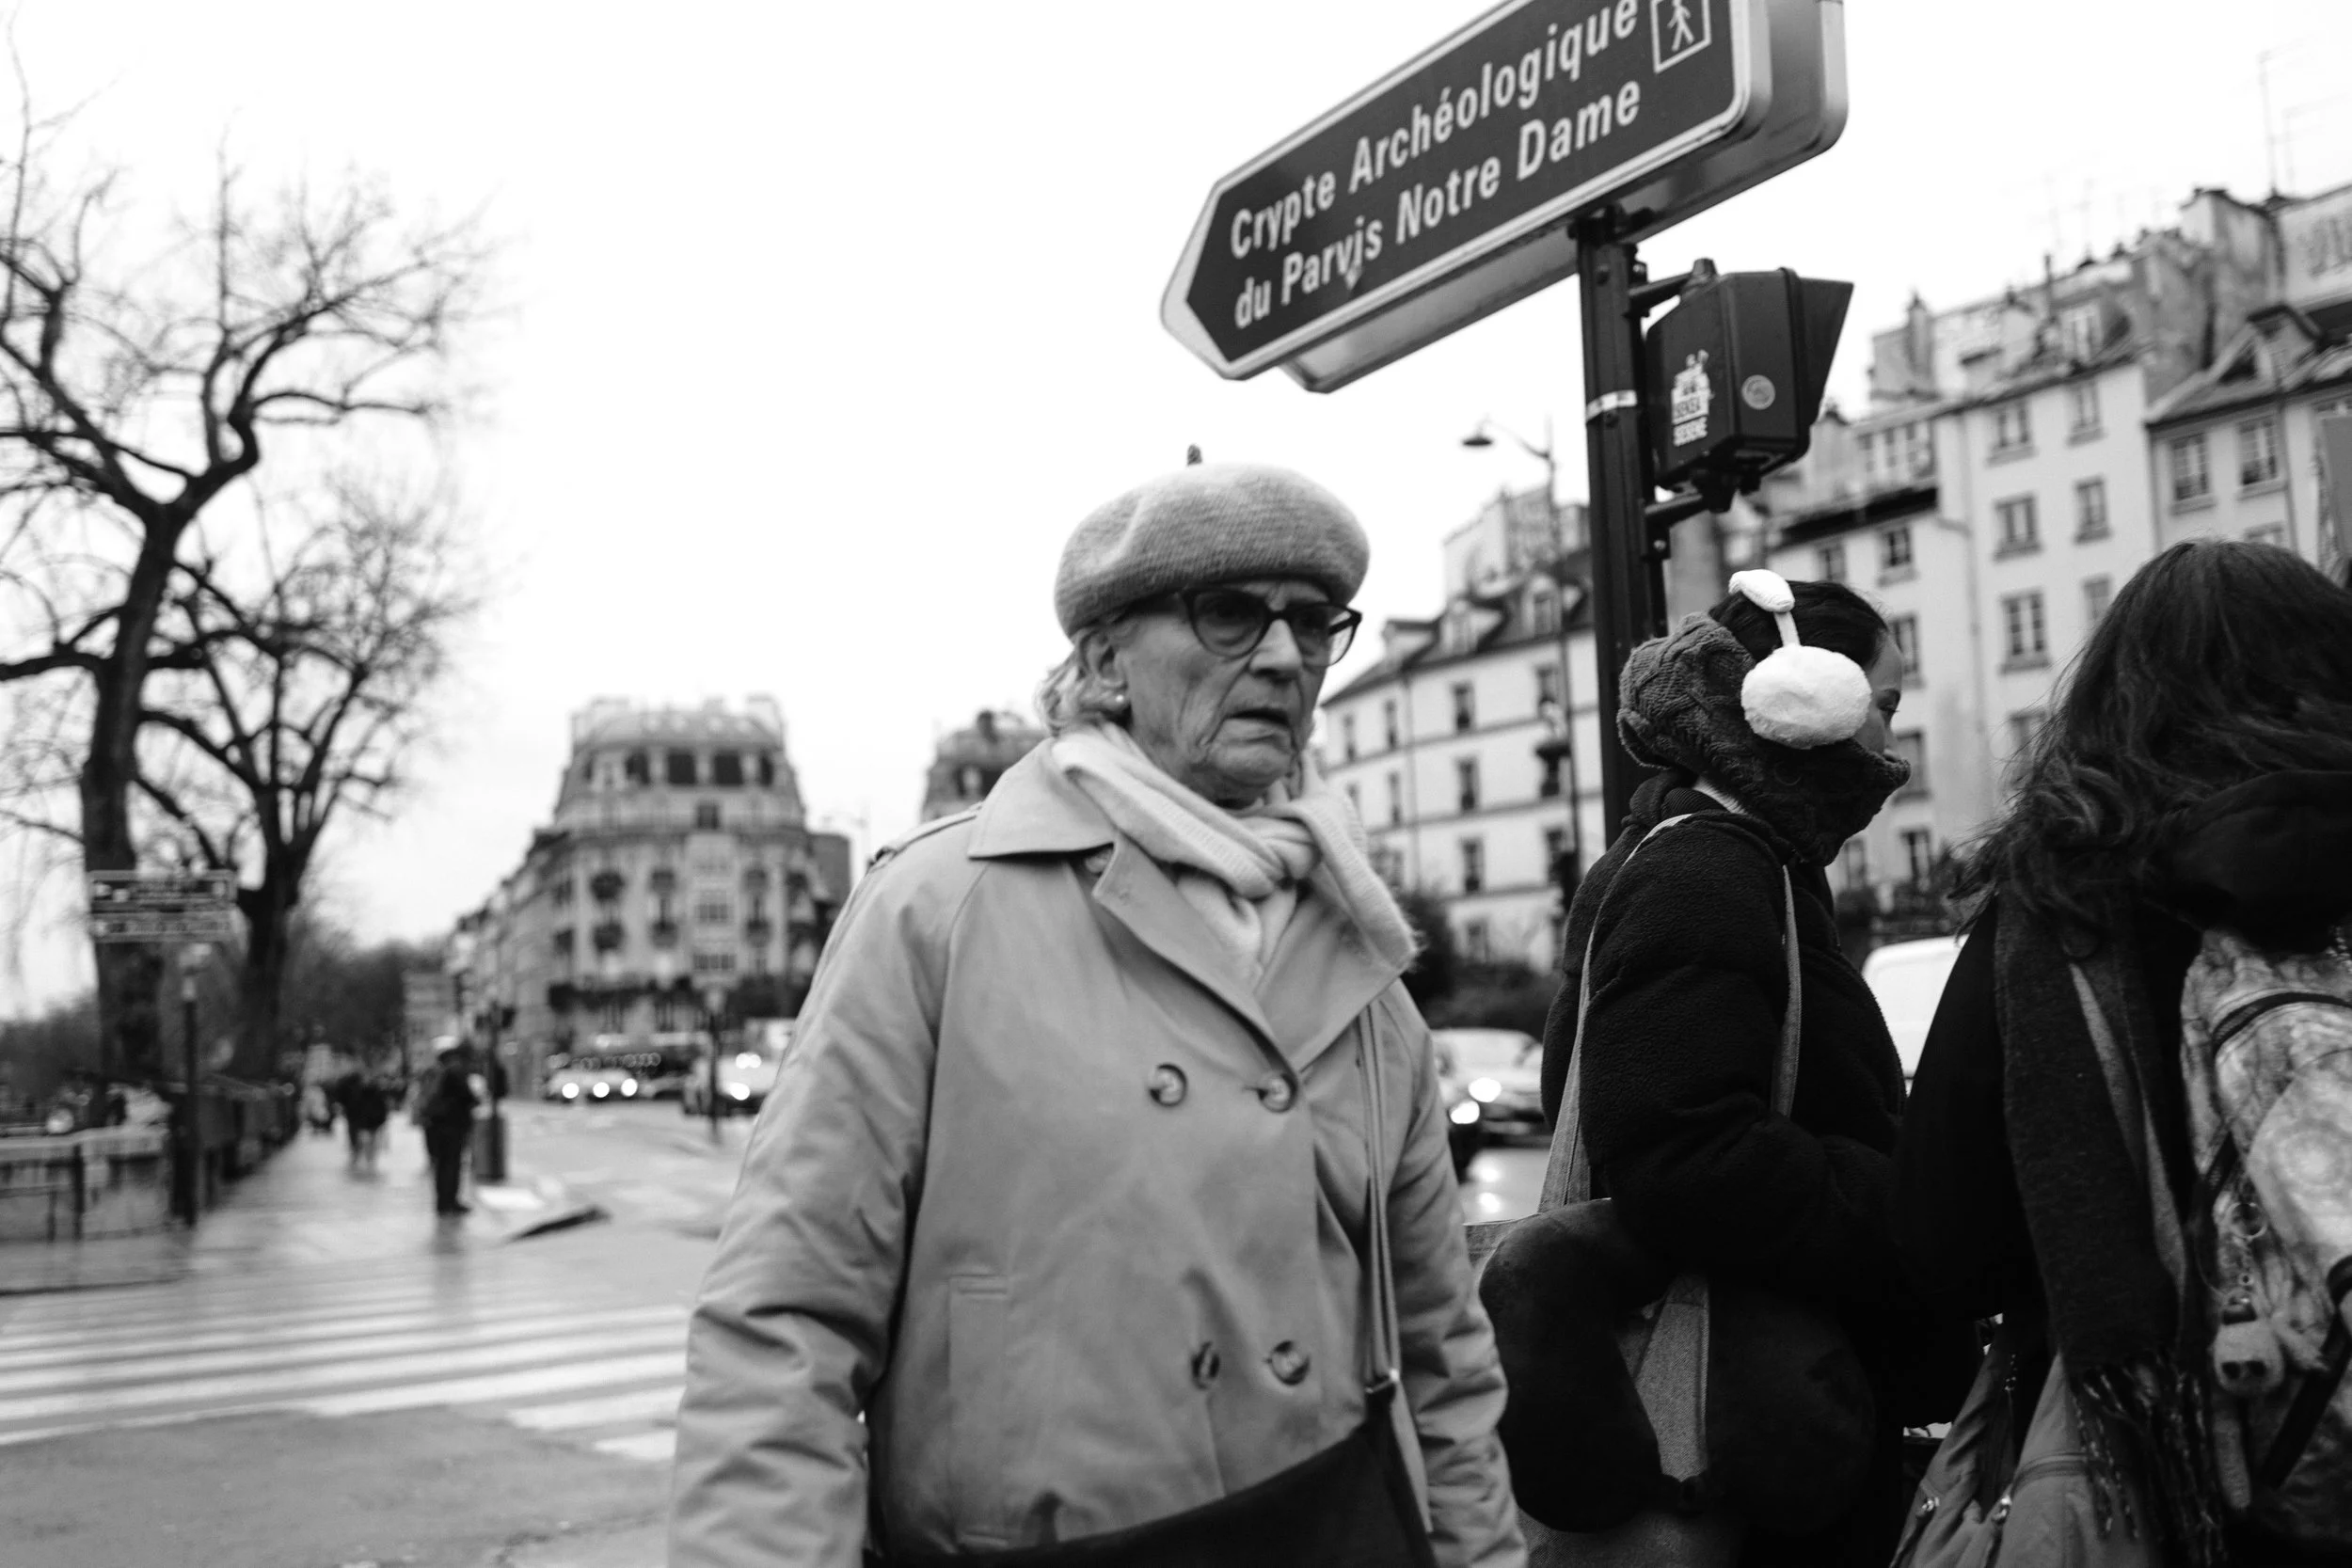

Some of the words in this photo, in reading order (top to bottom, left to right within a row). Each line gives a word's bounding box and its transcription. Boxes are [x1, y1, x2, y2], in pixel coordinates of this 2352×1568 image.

[1231, 171, 1336, 259] Crypte
[1348, 0, 1638, 194] Archéologique
[1234, 277, 1271, 328] du
[1280, 215, 1383, 306] Parvis
[1396, 156, 1502, 245] Notre
[1517, 81, 1640, 181] Dame
